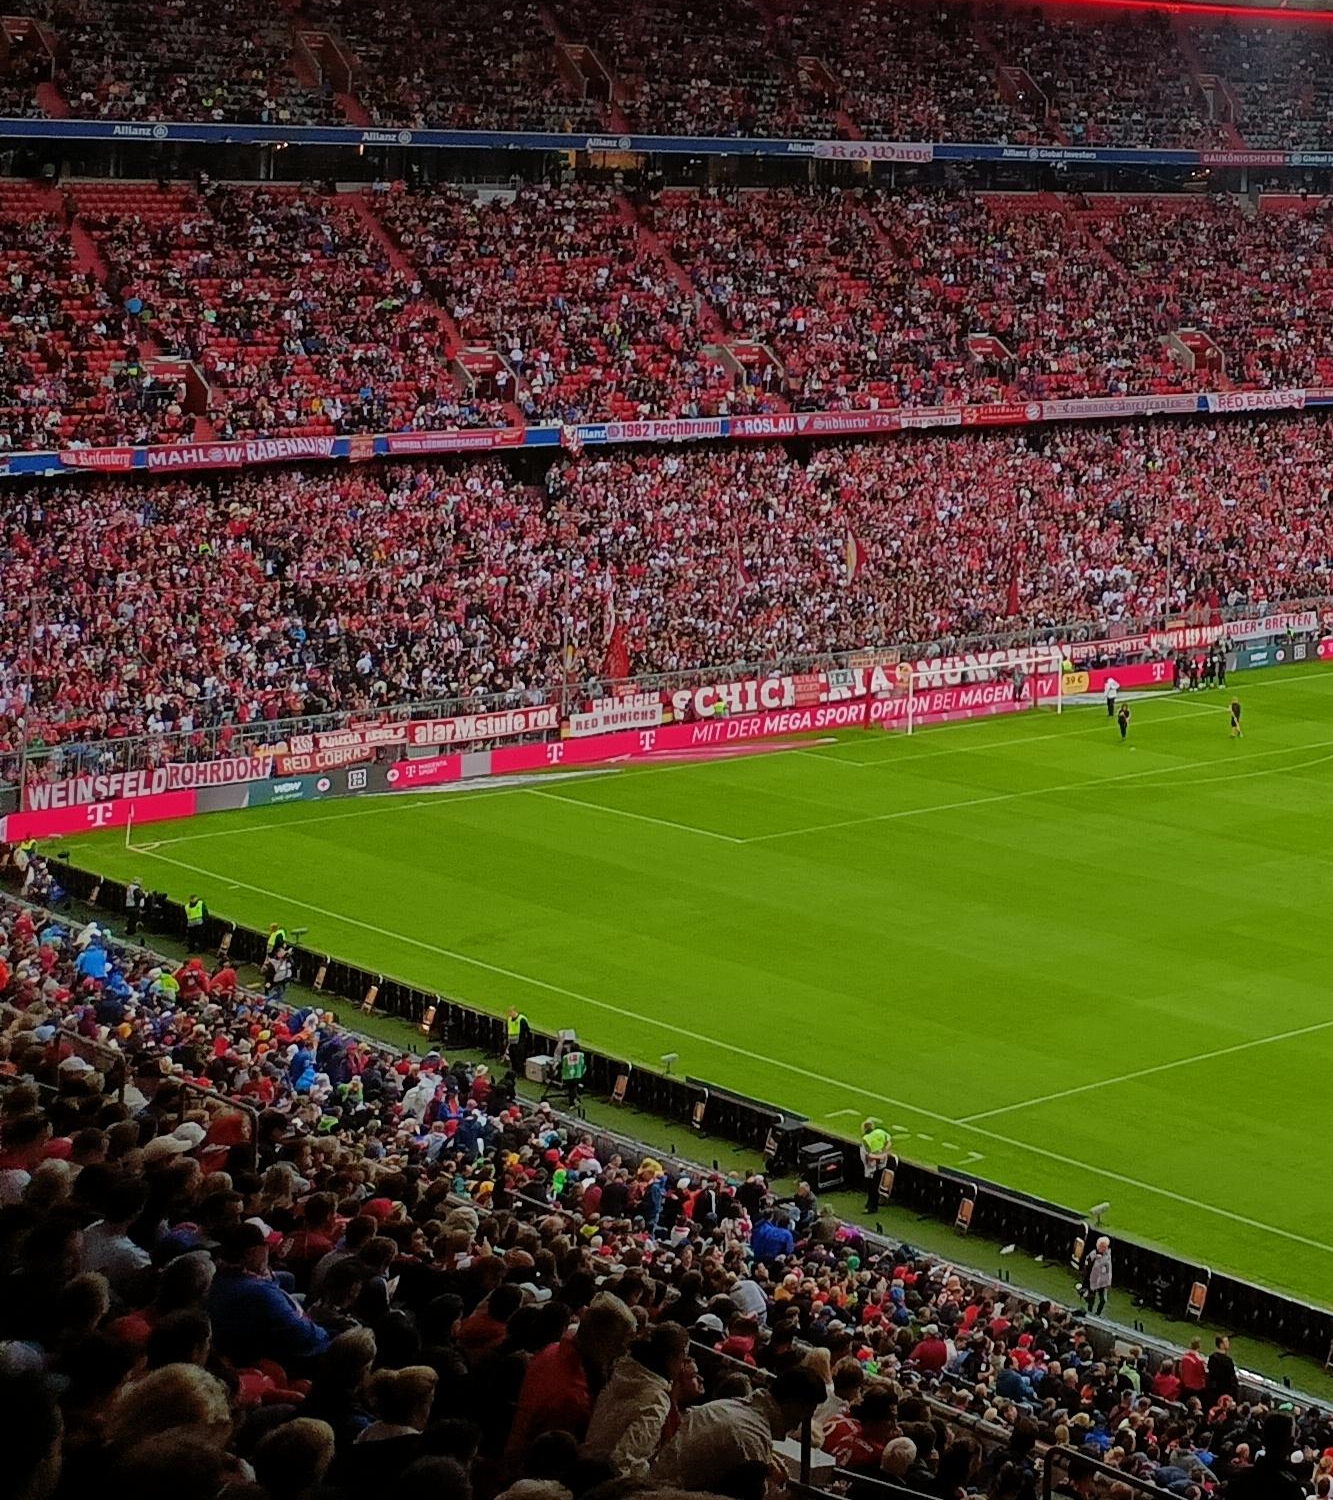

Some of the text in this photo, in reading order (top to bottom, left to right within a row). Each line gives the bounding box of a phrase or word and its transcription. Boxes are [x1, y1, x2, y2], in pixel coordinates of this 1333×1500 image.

[113, 125, 151, 135] Allianz
[362, 132, 397, 142] Allianz
[587, 138, 617, 147] Allianz
[1002, 149, 1027, 157] Allianz
[1064, 151, 1096, 159] Investors
[1219, 394, 1295, 408] RED EAGLES
[578, 426, 607, 439] llianz
[621, 421, 720, 438] 1982 Pechbrunn
[745, 417, 794, 434] ROSLAU
[1226, 622, 1257, 637] ADLER
[1265, 614, 1312, 631] BRETTEN
[692, 723, 724, 744] MIT
[727, 718, 761, 739] DER
[764, 711, 811, 733] MEGA
[815, 704, 866, 726] SPORT
[871, 695, 930, 719] OPTION
[934, 692, 956, 709] BEI
[959, 683, 1030, 707] MAGENA
[414, 711, 526, 744] alarMstufe
[528, 707, 559, 729] rot
[575, 714, 598, 731] RED
[283, 747, 371, 771] RED COBRAS
[169, 757, 272, 788] ROHRDORF
[28, 768, 168, 811] WEINSFELD
